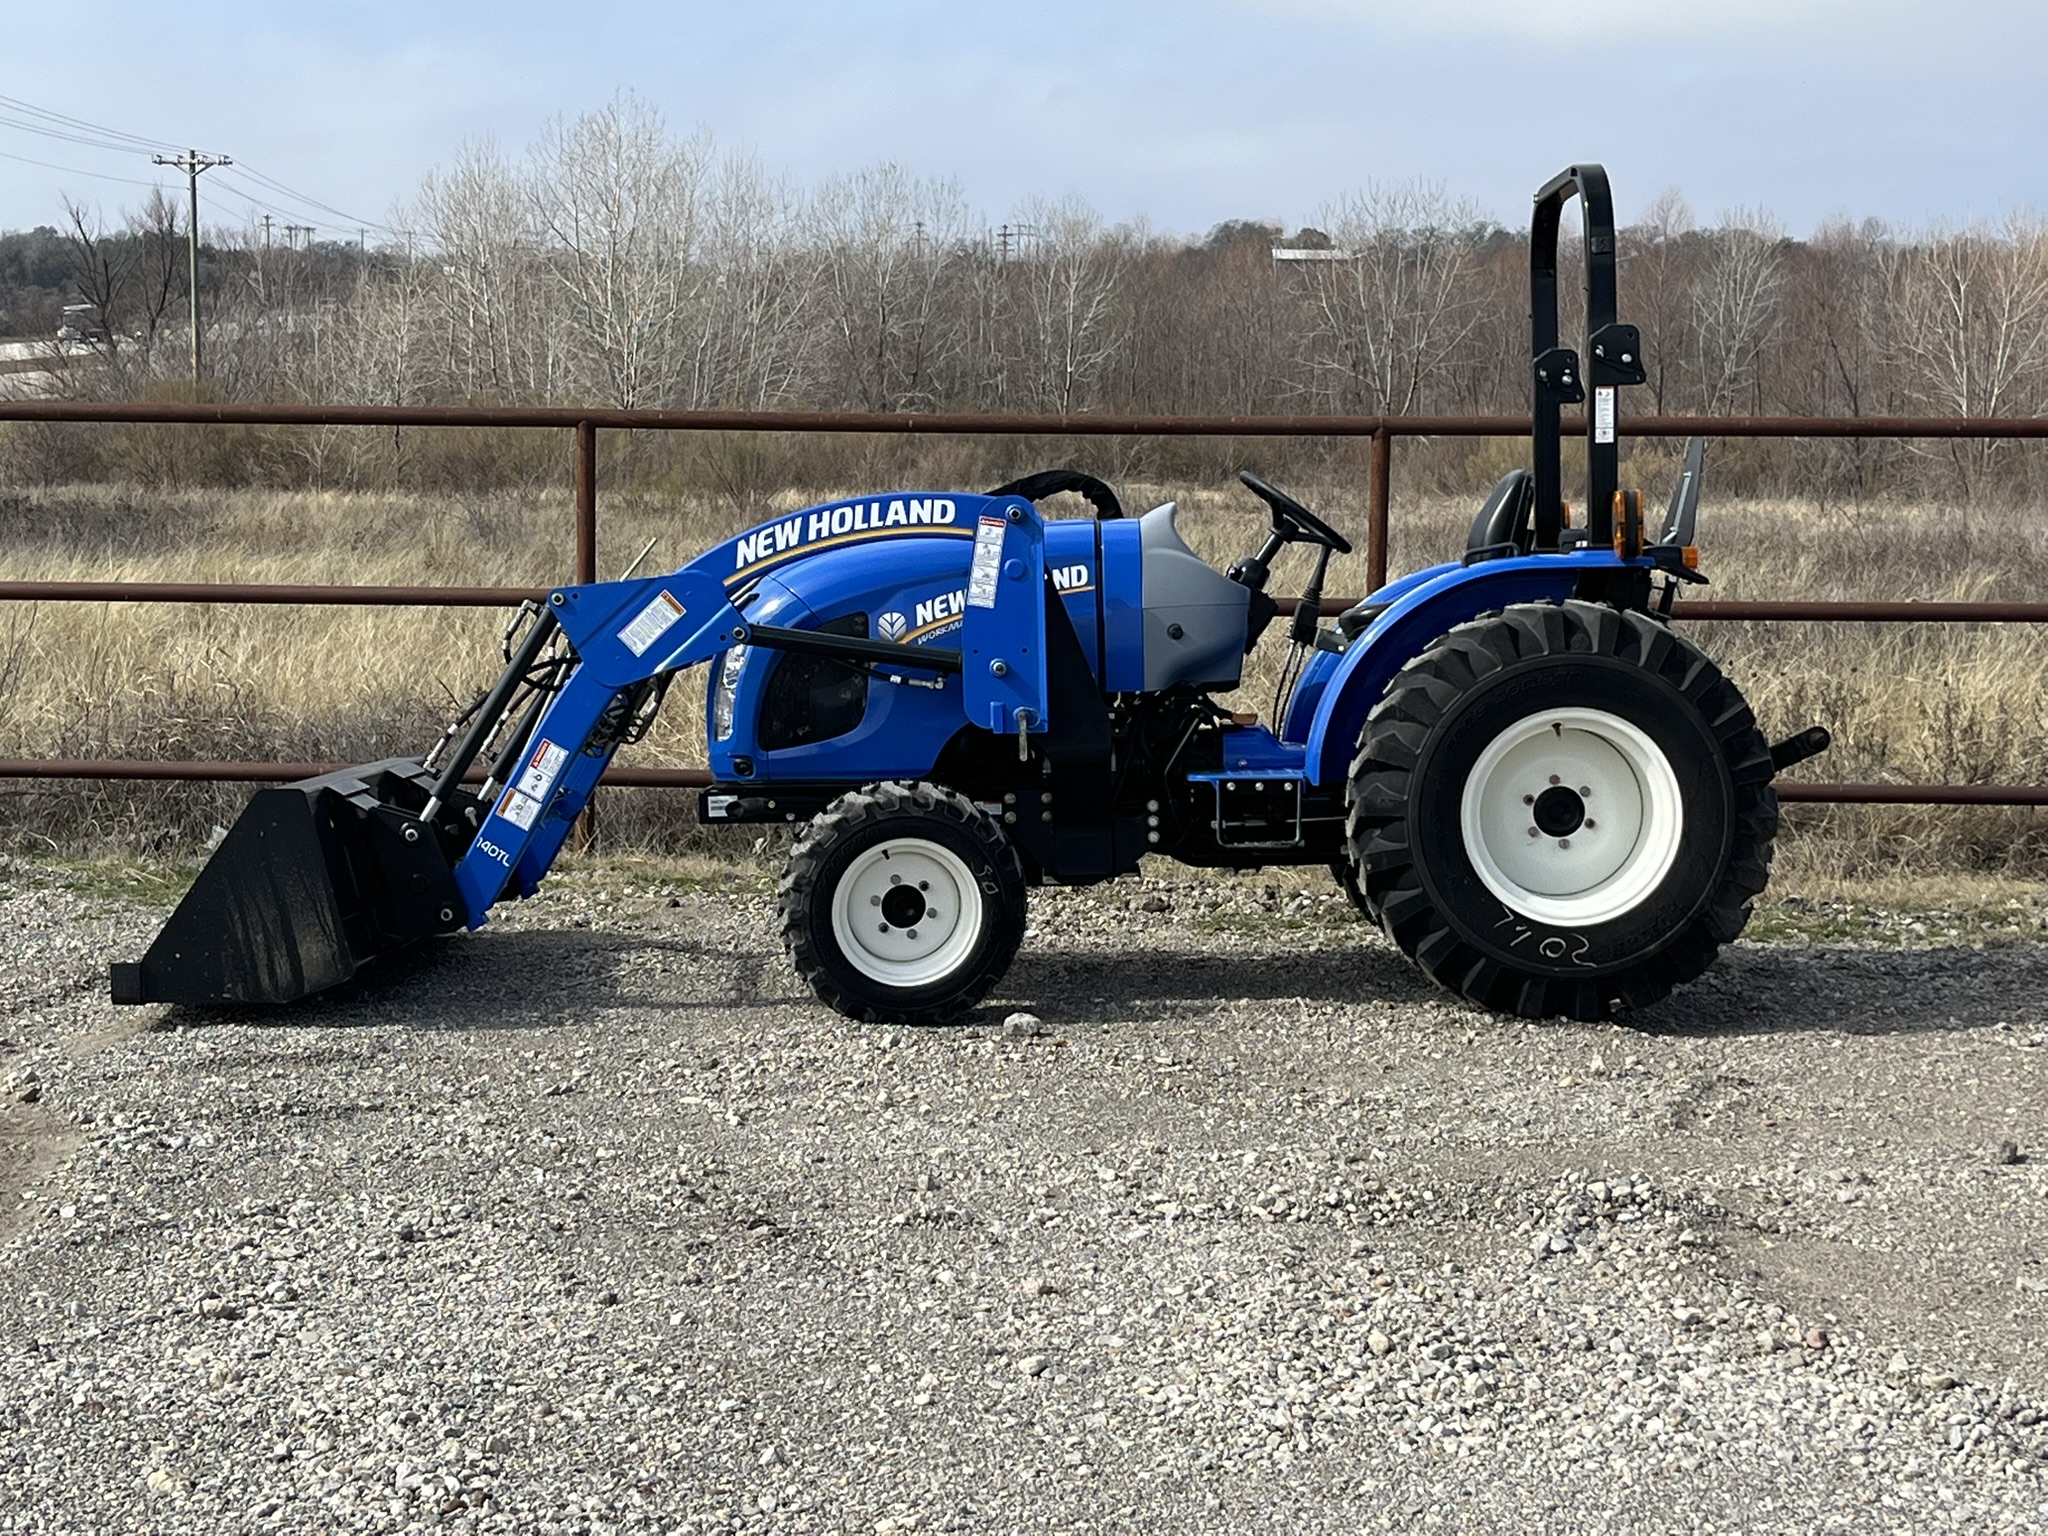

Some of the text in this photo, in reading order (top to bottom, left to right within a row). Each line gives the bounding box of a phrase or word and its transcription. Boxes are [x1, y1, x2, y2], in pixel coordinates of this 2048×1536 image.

[735, 498, 956, 569] NEW HOLLAND
[915, 564, 1089, 627] NEW ND
[477, 836, 510, 867] 140TL
